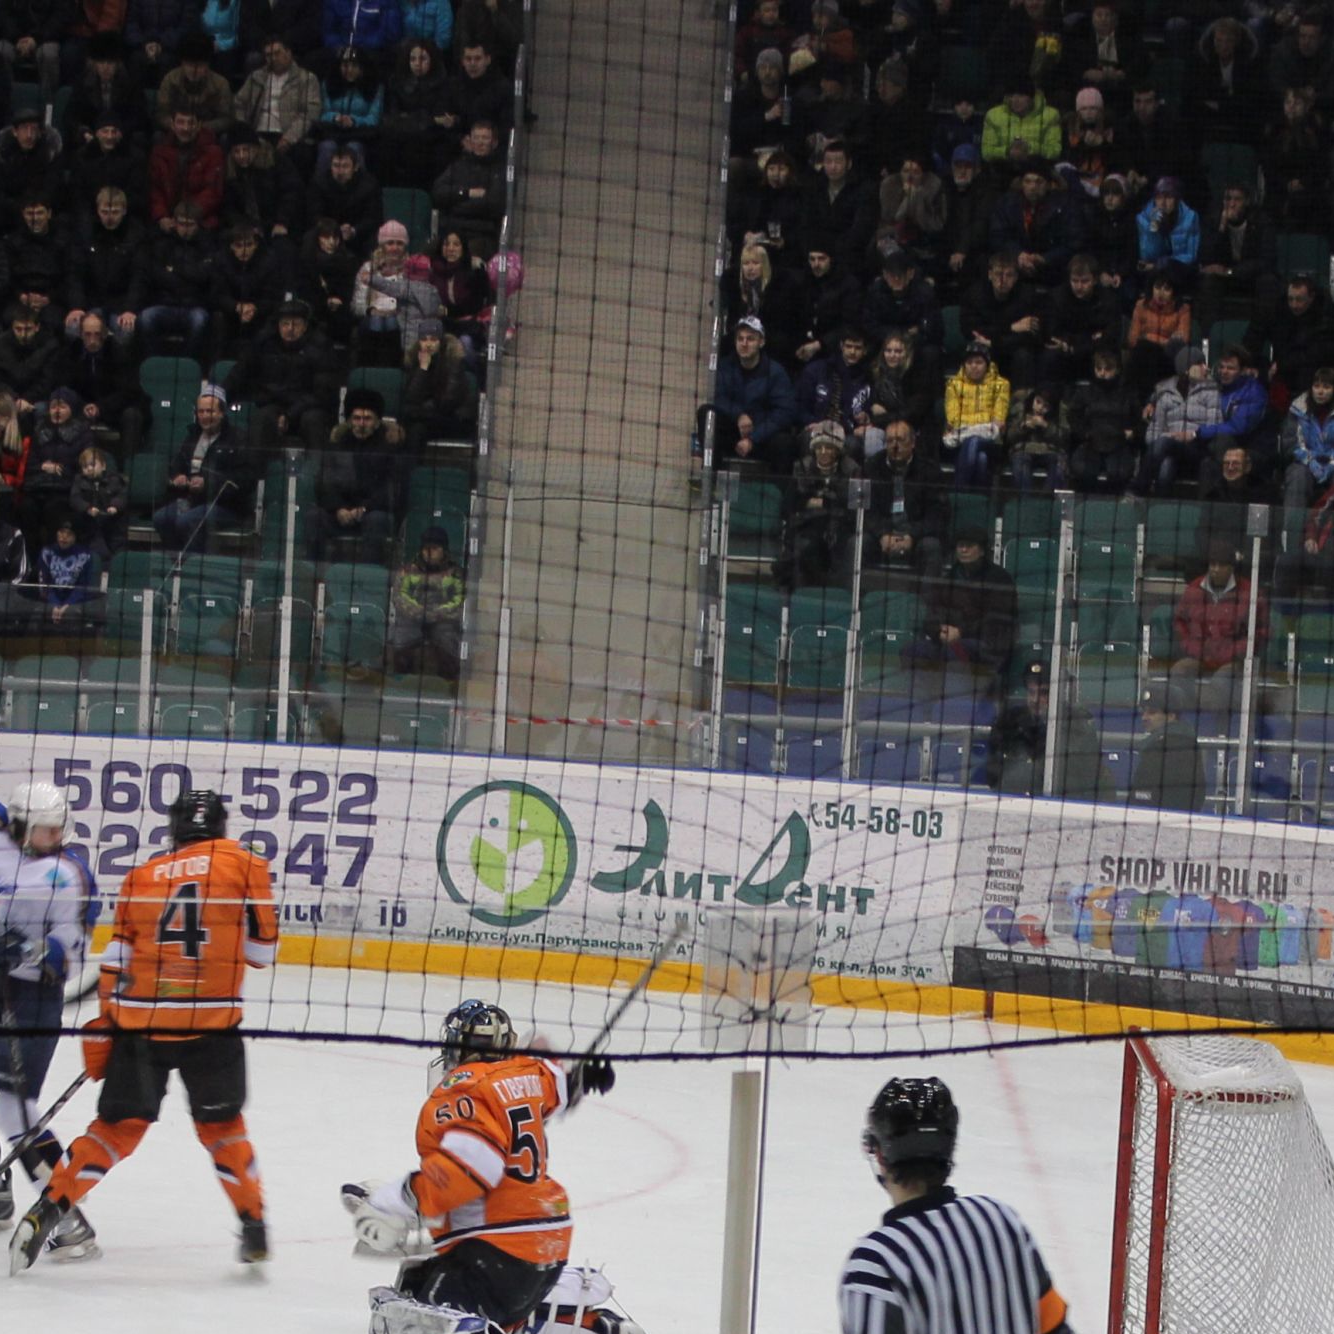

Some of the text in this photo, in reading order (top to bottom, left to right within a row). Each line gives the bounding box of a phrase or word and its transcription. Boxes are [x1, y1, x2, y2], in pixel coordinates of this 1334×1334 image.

[824, 802, 944, 839] 54-58-03
[155, 881, 212, 960] 4
[434, 1095, 476, 1126] 50
[505, 1101, 549, 1185] 5
